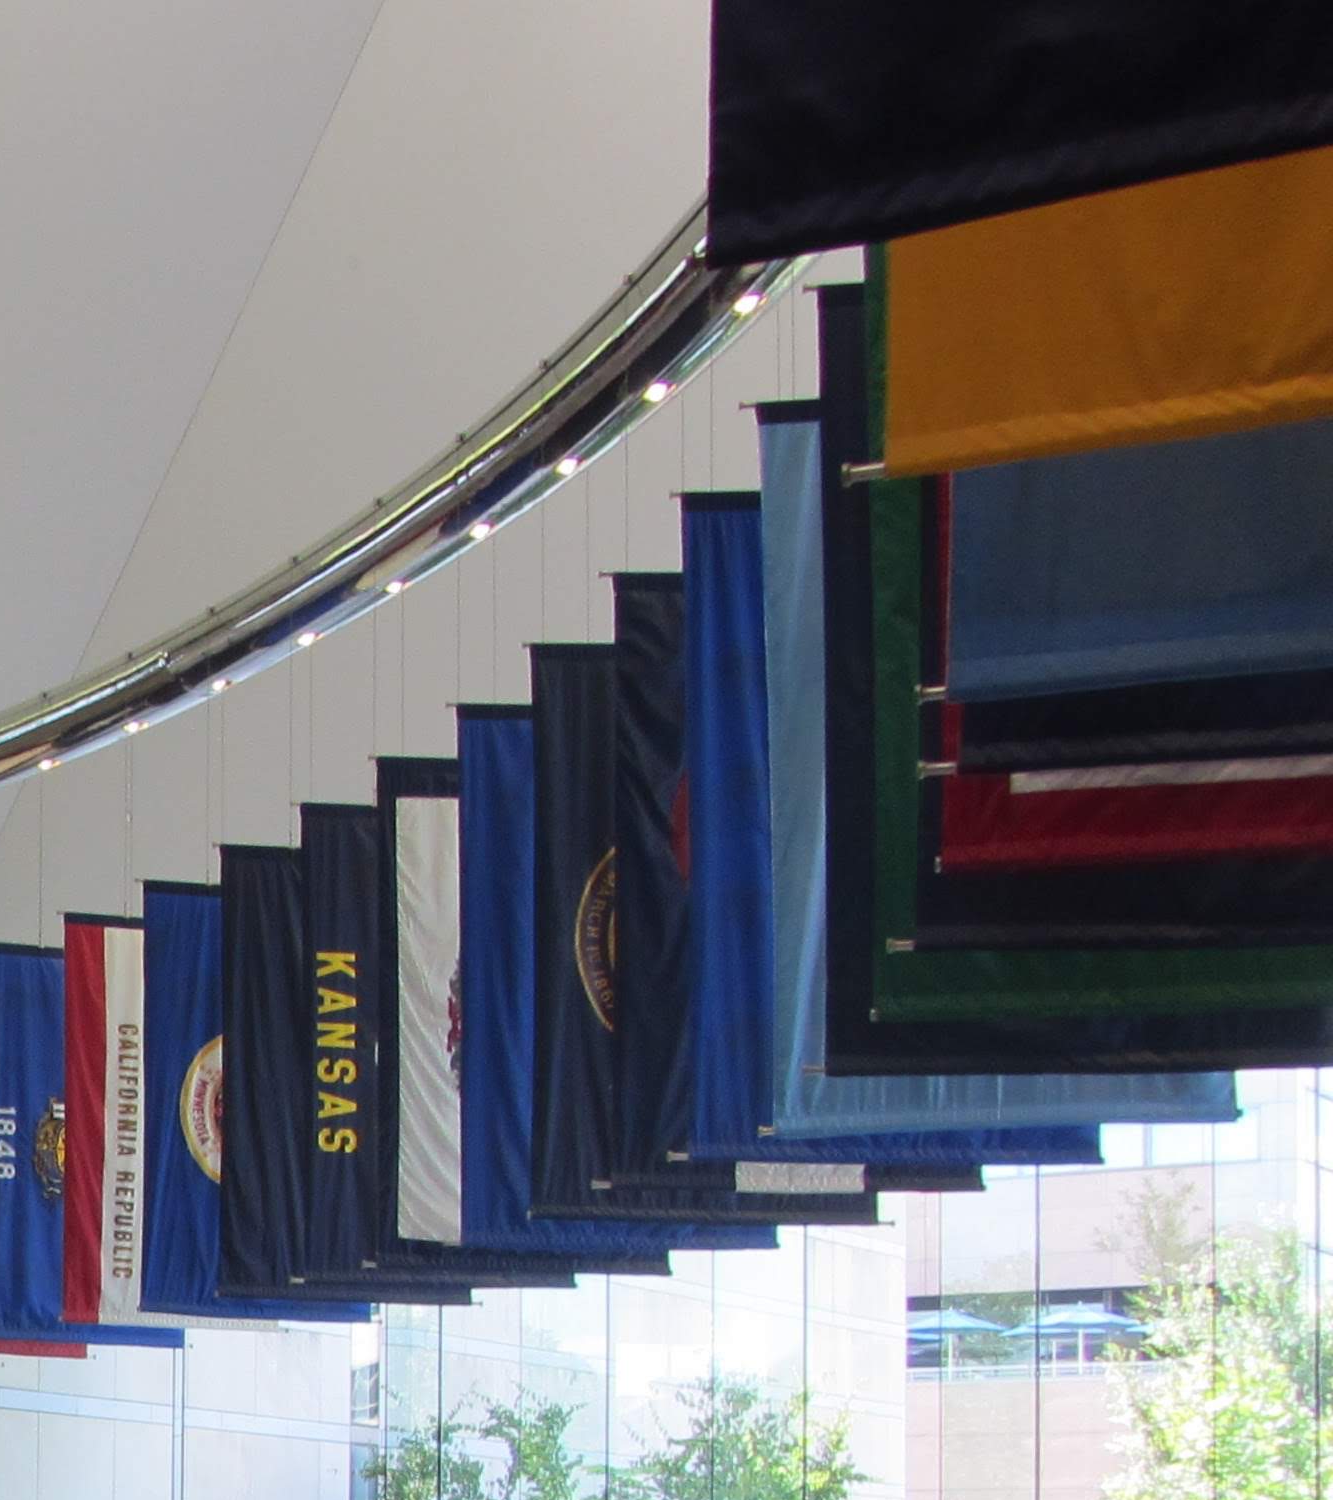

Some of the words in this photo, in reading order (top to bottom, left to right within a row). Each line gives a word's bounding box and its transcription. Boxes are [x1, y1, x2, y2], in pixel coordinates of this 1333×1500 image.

[117, 1023, 139, 1156] CALIFORNIA
[192, 1079, 210, 1146] MINNESOTA
[315, 952, 357, 1153] KANSAS
[112, 1171, 135, 1279] REPUBLIC
